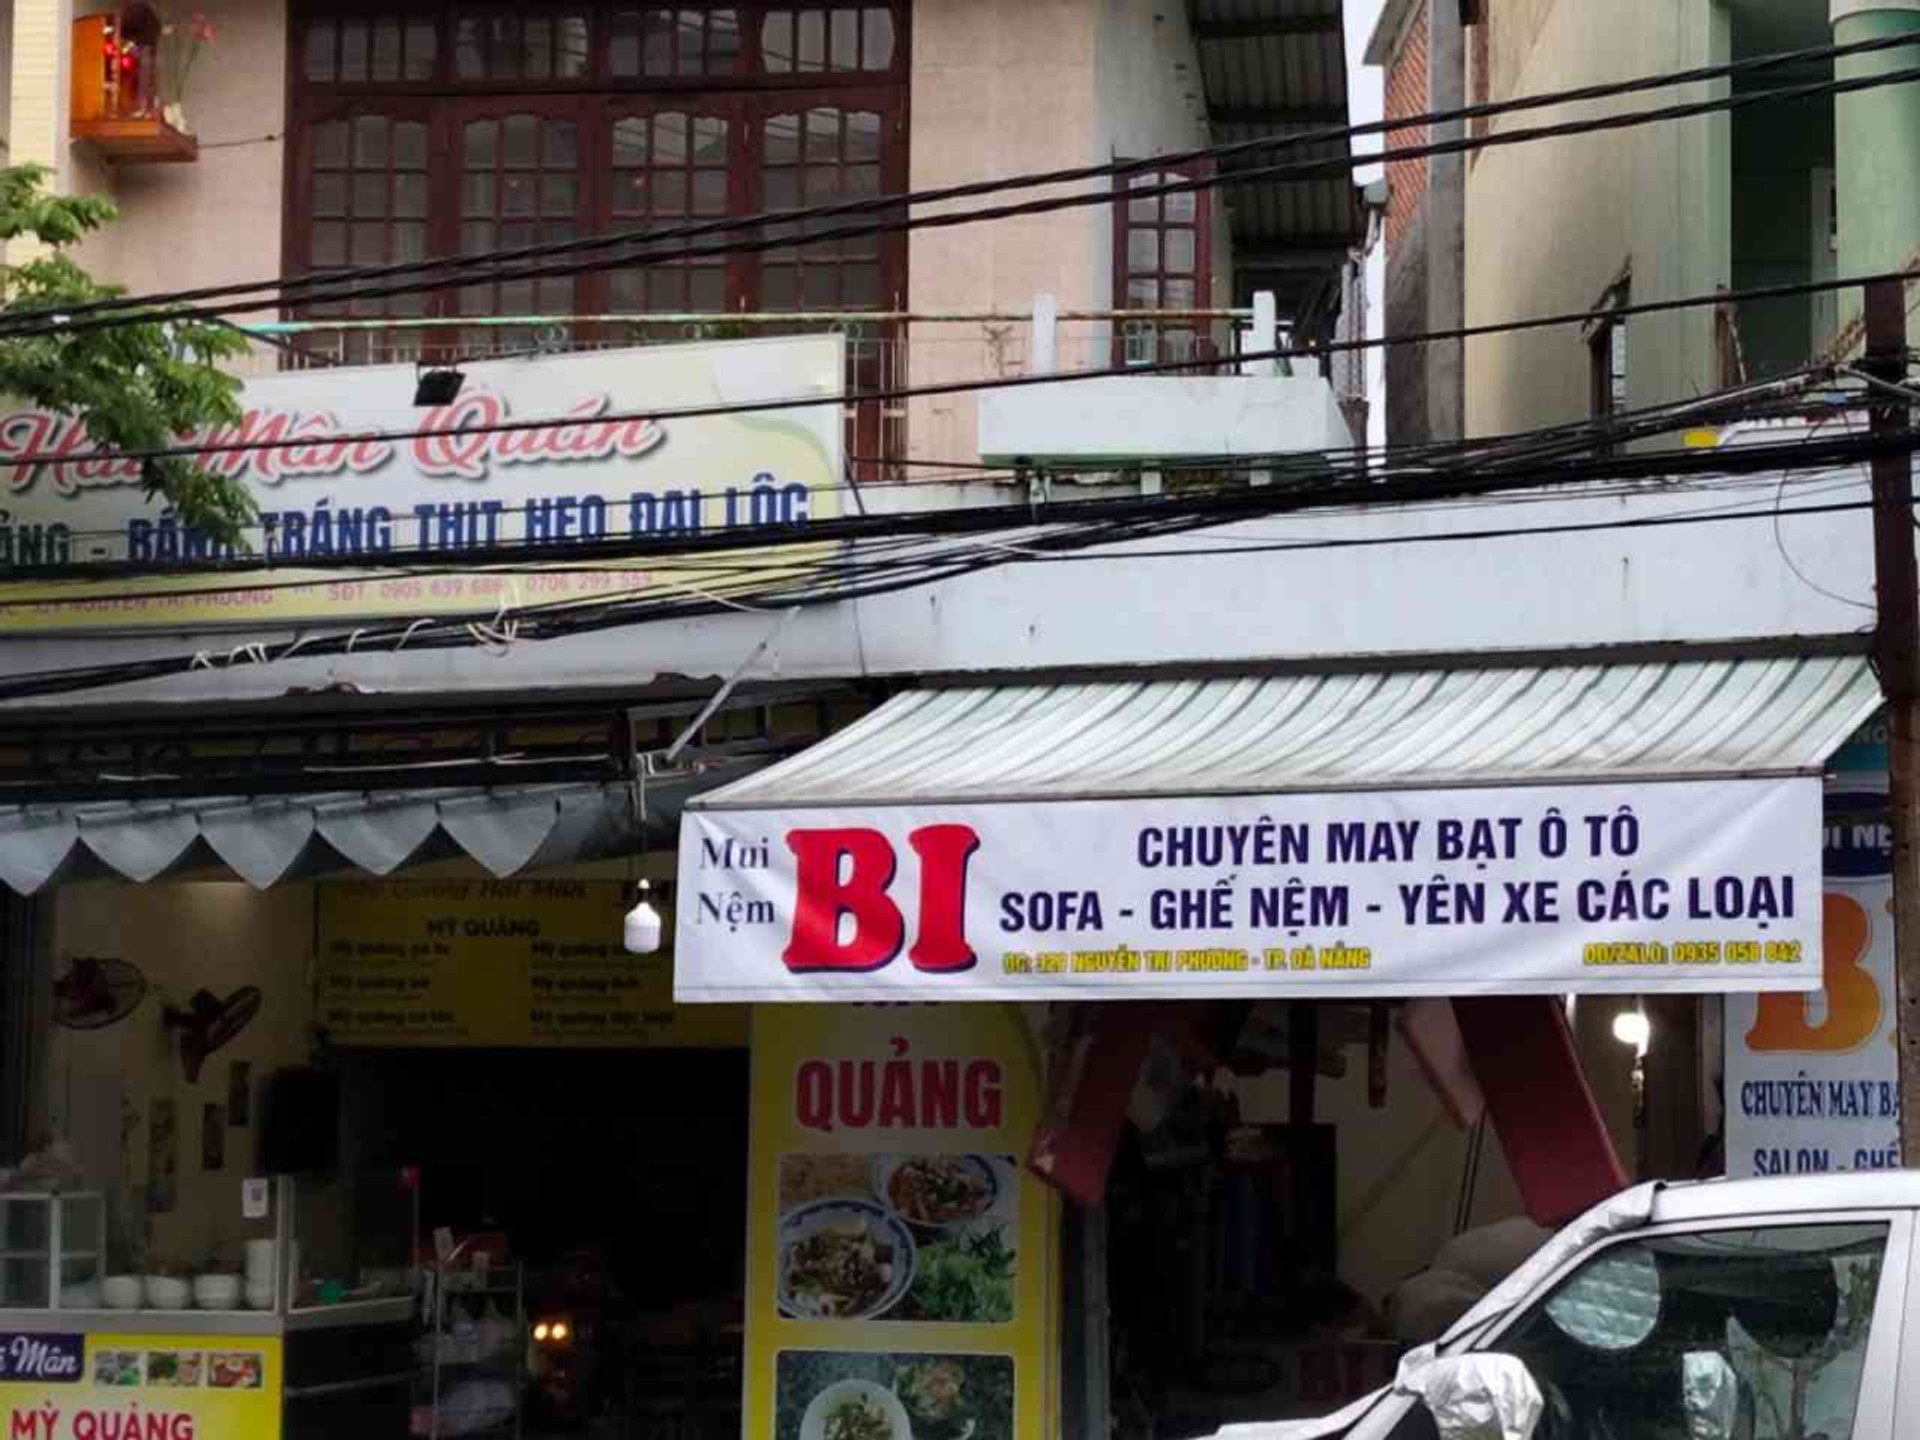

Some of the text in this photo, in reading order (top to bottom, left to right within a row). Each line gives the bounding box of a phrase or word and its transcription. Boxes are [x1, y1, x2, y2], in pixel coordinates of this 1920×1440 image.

[411, 392, 664, 478] Quán
[1138, 804, 1640, 870] CHUYÊN MAY BẠT Ô TÔ
[697, 891, 776, 932] Nệm
[781, 824, 981, 974] BI
[1000, 890, 1104, 932] SOFA
[1150, 874, 1238, 929] GHẾ
[1250, 877, 1349, 937] NỆM
[1400, 874, 1486, 926] YÊN
[1503, 881, 1560, 924] XE
[1577, 870, 1669, 923] CÁC
[1688, 875, 1795, 929] LOẠI
[795, 1036, 1004, 1132] QUẢNG
[1828, 1080, 1876, 1117] MAY
[72, 1400, 194, 1440] QUẢNG
